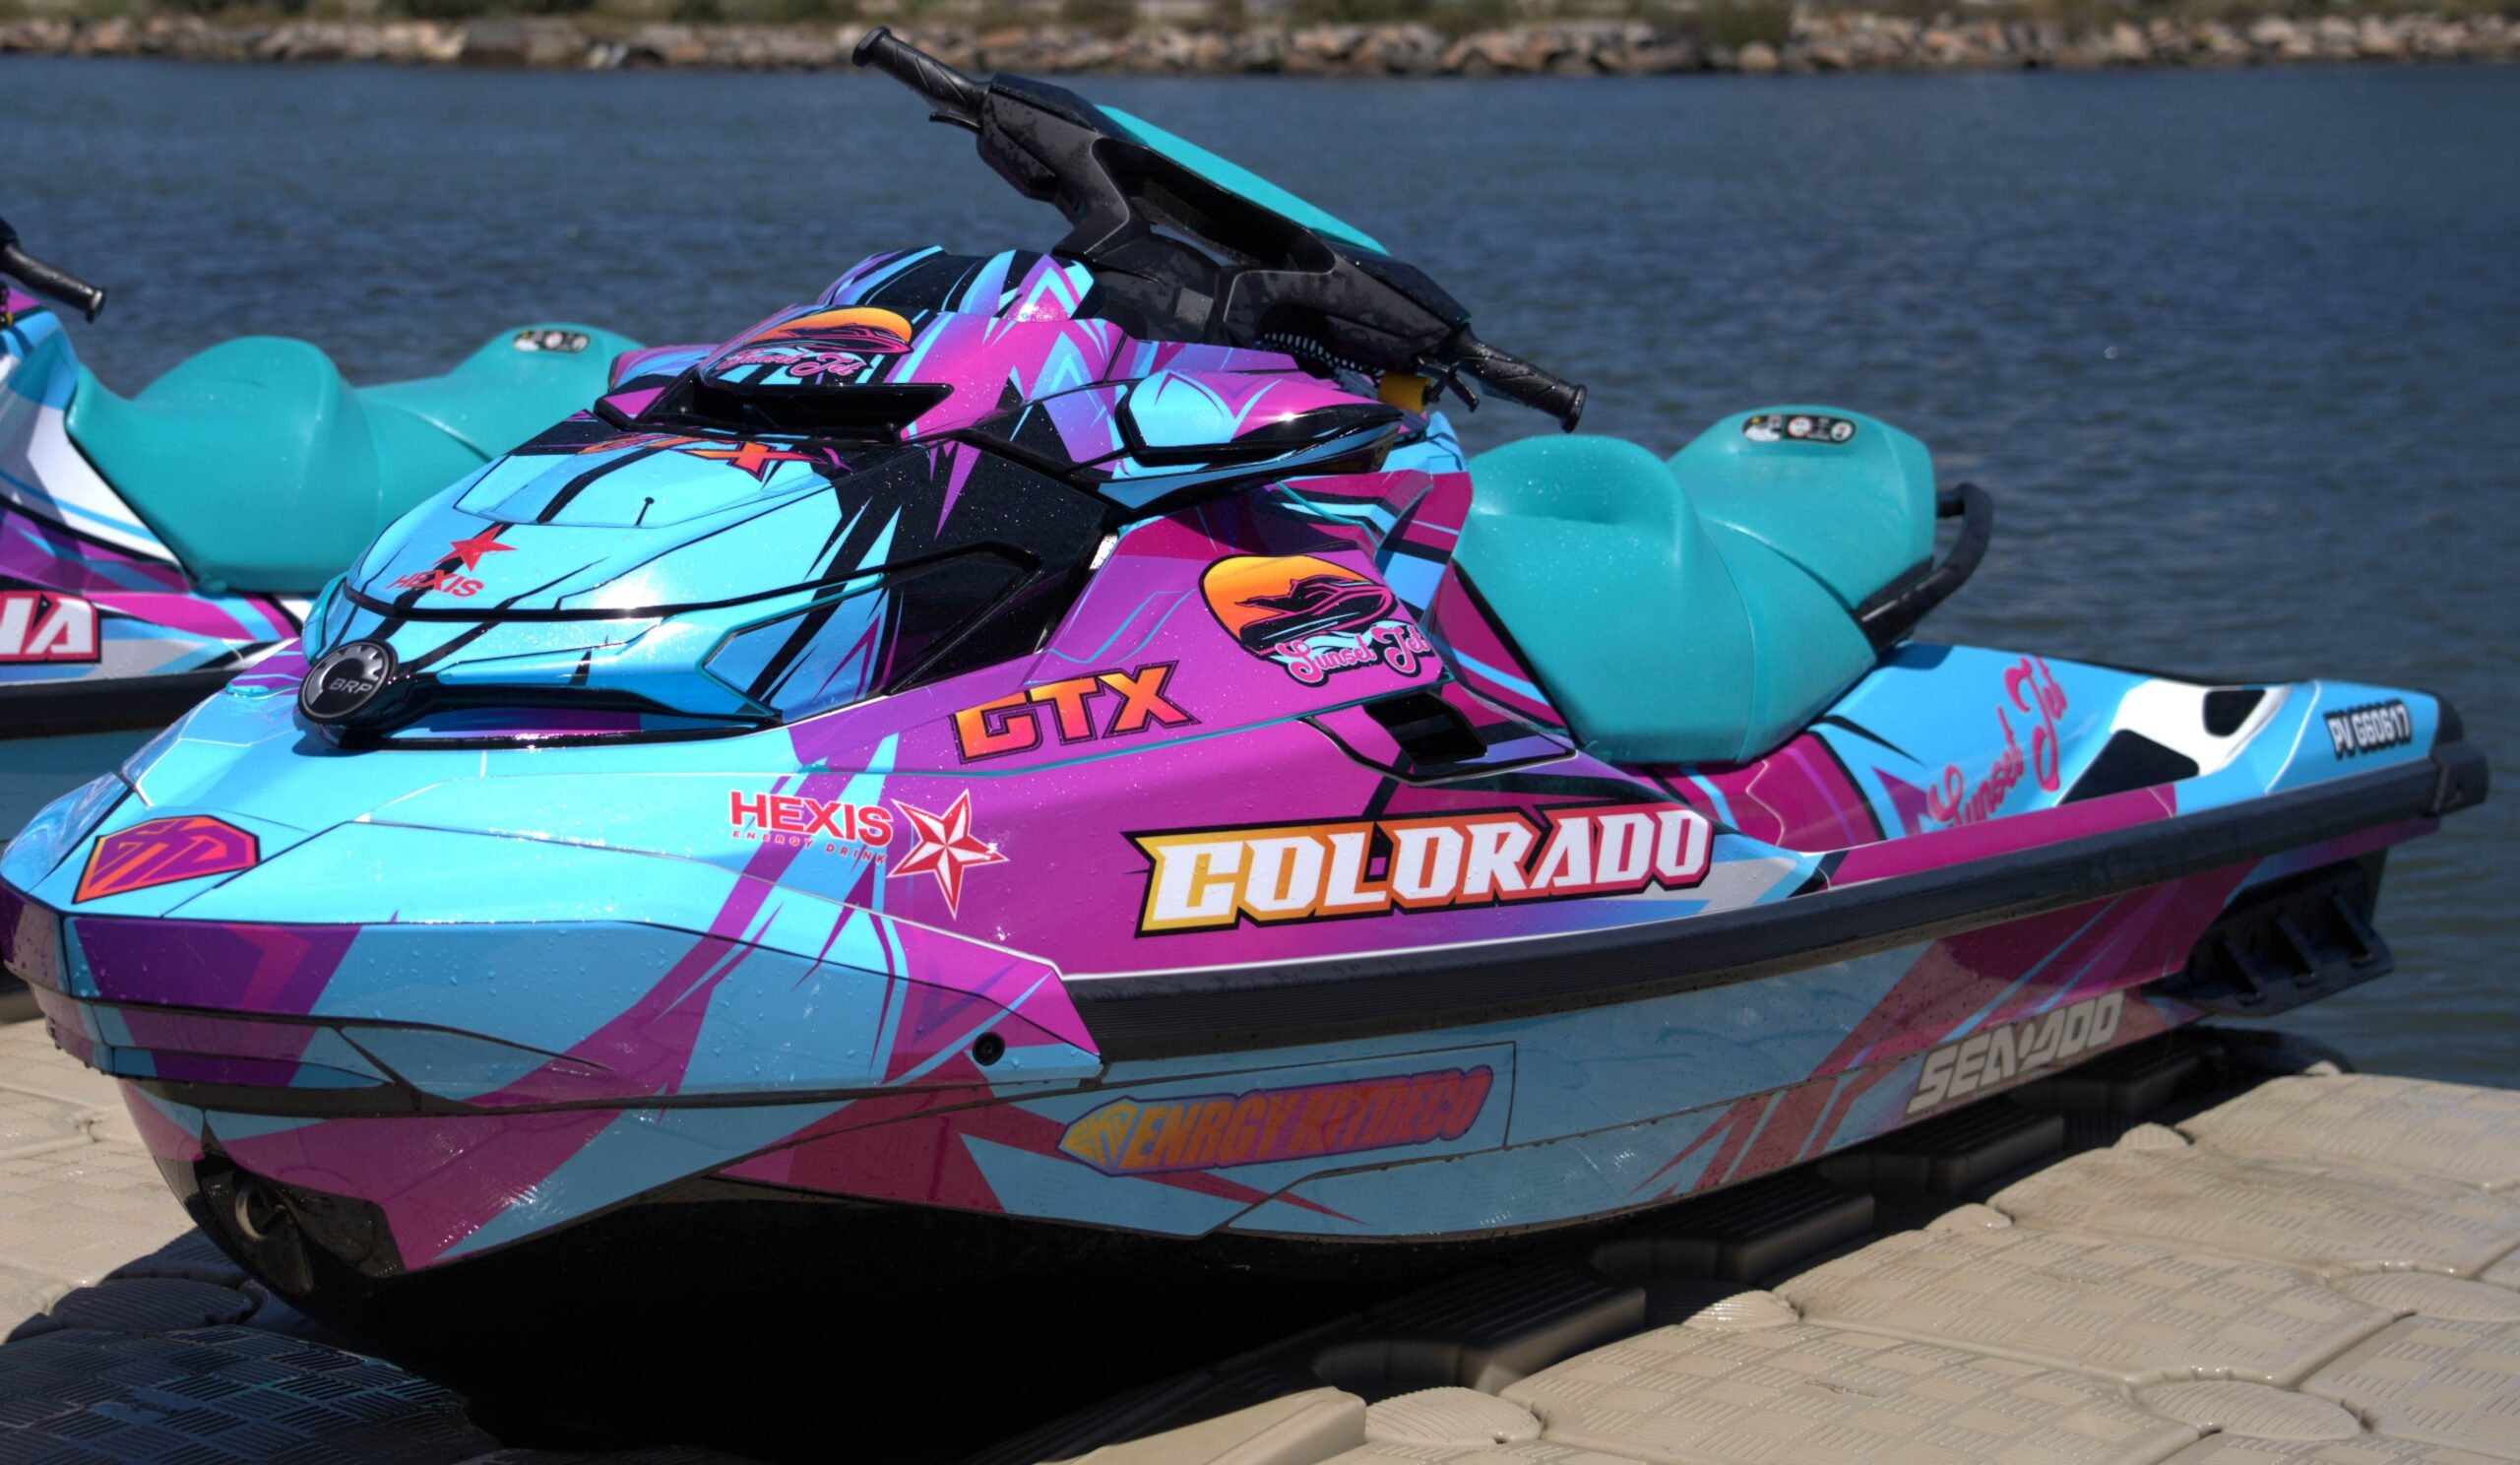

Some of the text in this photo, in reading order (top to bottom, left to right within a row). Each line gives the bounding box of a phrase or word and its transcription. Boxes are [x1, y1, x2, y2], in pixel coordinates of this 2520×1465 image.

[789, 351, 865, 377] Jet
[386, 568, 484, 598] HEXIS
[1276, 624, 1430, 684] Sunset Jet
[328, 676, 374, 695] BRP
[953, 665, 1193, 760] GTX
[1926, 655, 2068, 827] Sunset Jet
[2326, 702, 2412, 754] PV G60617
[729, 790, 894, 847] HEXIS
[731, 829, 888, 864] ENERGY DRINK
[1147, 807, 1709, 924] COLORADO
